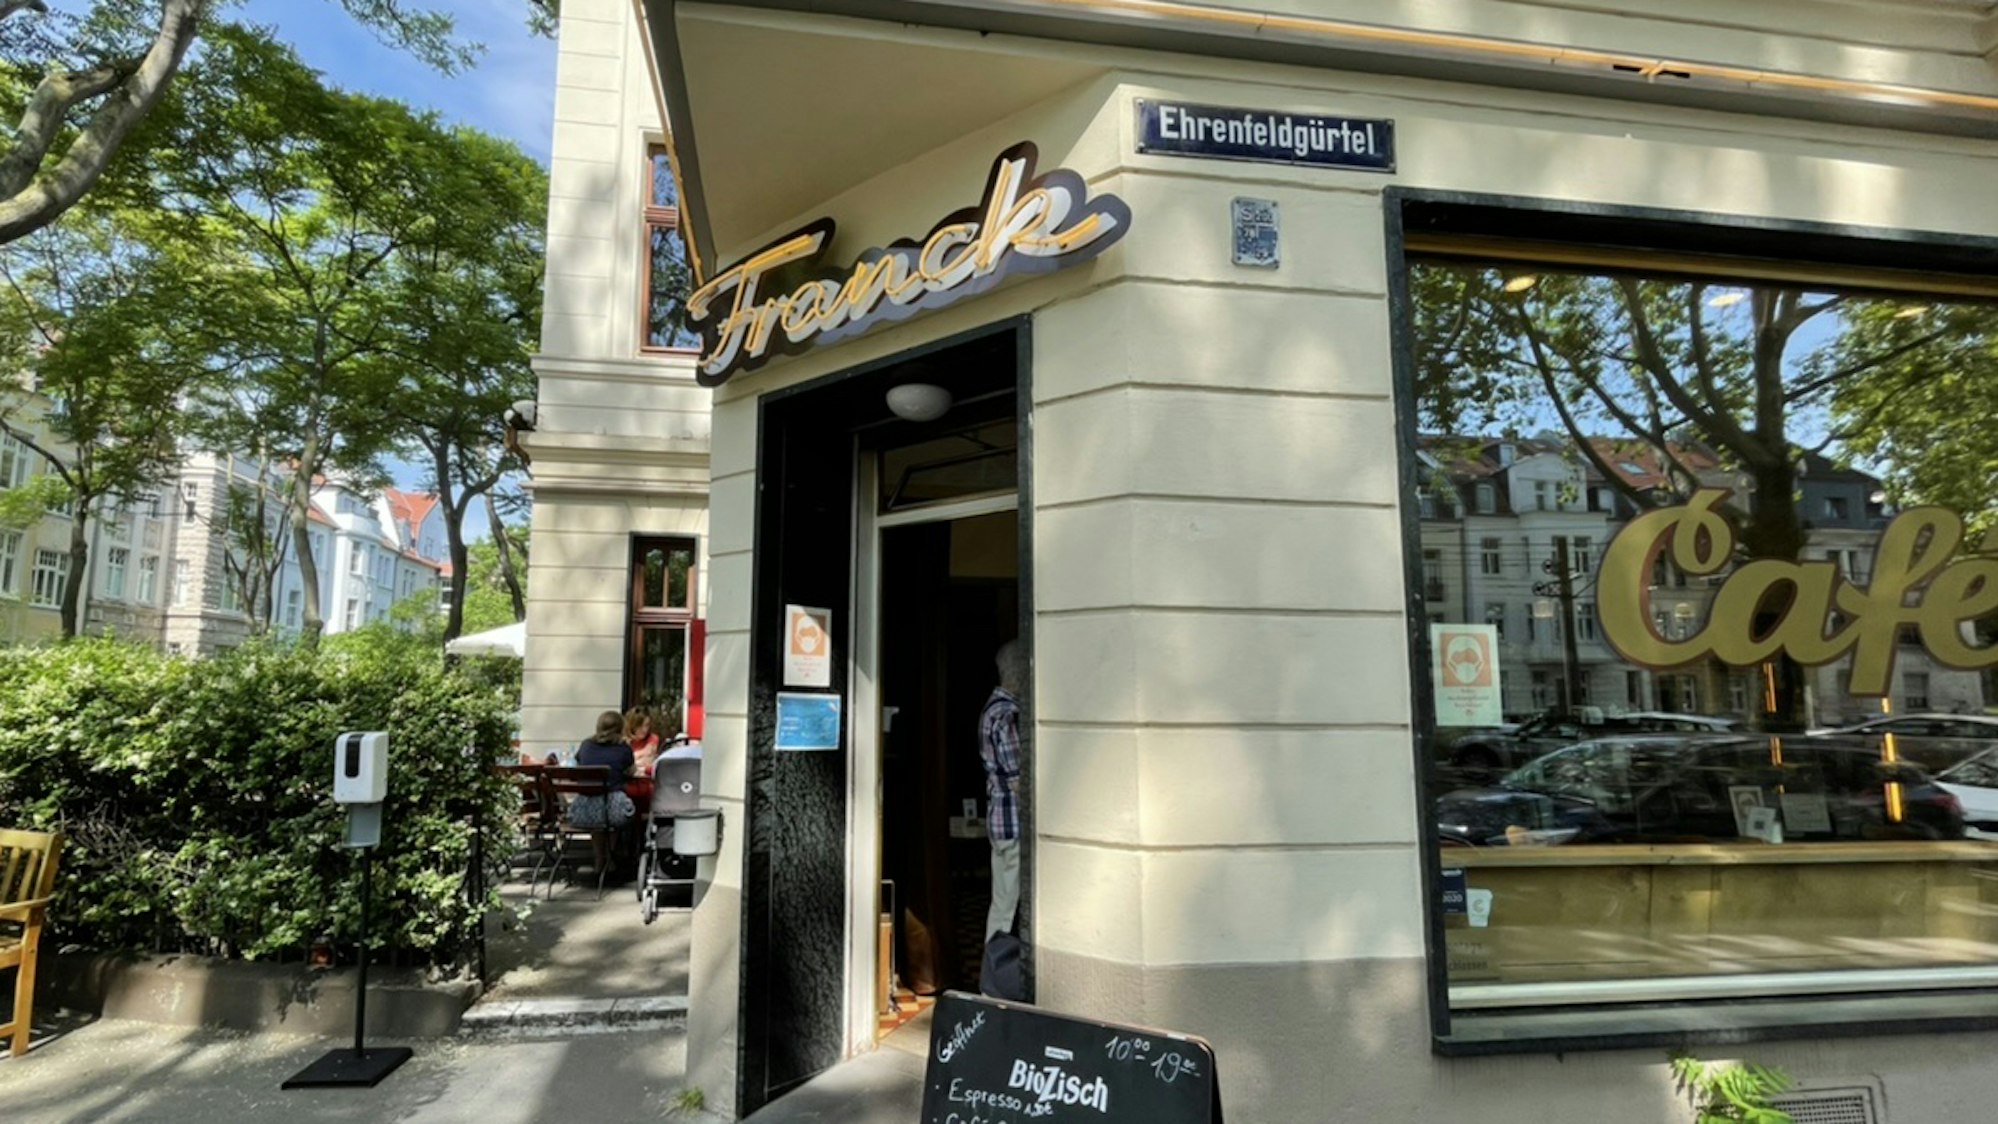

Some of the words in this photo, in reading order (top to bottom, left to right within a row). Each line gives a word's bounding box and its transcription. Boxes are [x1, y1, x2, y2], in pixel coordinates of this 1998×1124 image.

[1159, 105, 1375, 157] Ehrenfeldgürtel
[686, 156, 1118, 376] Franck
[1597, 488, 1998, 697] Café
[949, 1078, 1022, 1108] Espresso
